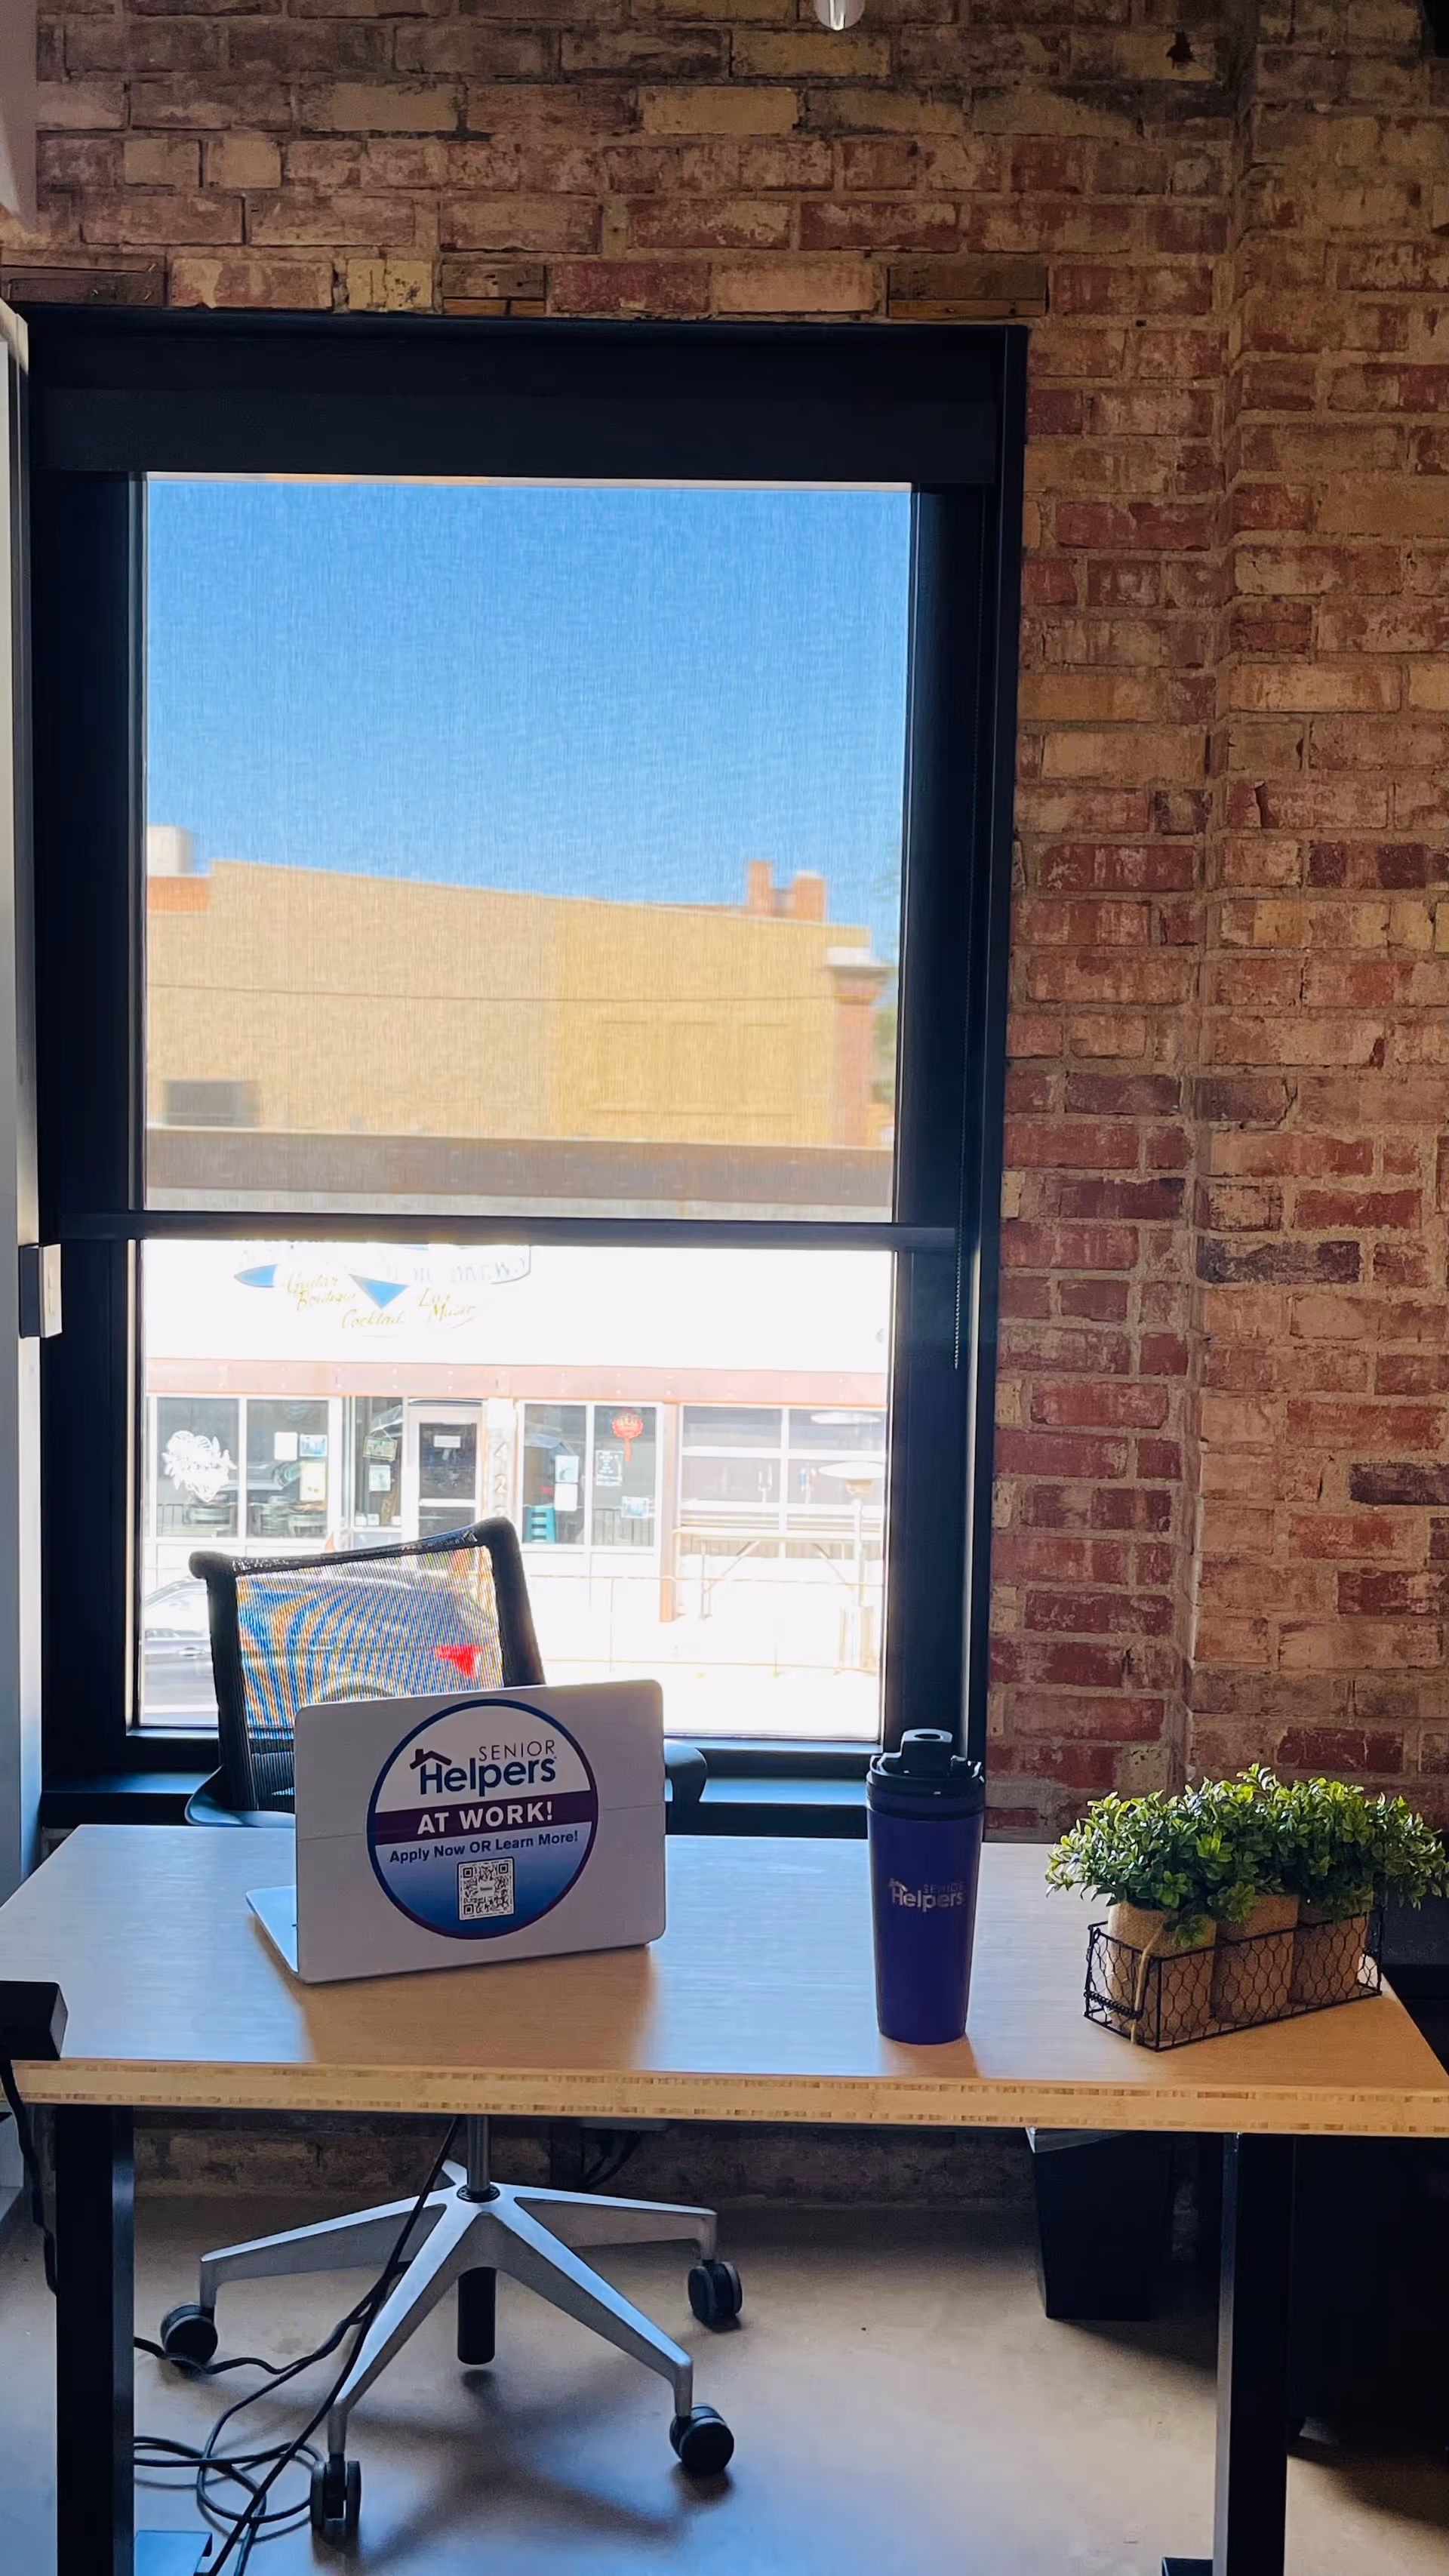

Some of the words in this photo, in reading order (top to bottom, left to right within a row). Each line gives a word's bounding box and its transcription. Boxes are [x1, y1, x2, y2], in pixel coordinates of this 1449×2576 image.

[478, 1740, 555, 1762] SENIOR
[420, 1758, 556, 1797] Helpers
[417, 1812, 449, 1835] AT
[460, 1801, 552, 1830] WORK!
[390, 1848, 429, 1864] Apply
[435, 1845, 465, 1858] Now
[469, 1840, 491, 1854] OR
[496, 1837, 534, 1851] Learn
[538, 1830, 579, 1845] More!
[892, 1889, 964, 1912] Helpers
